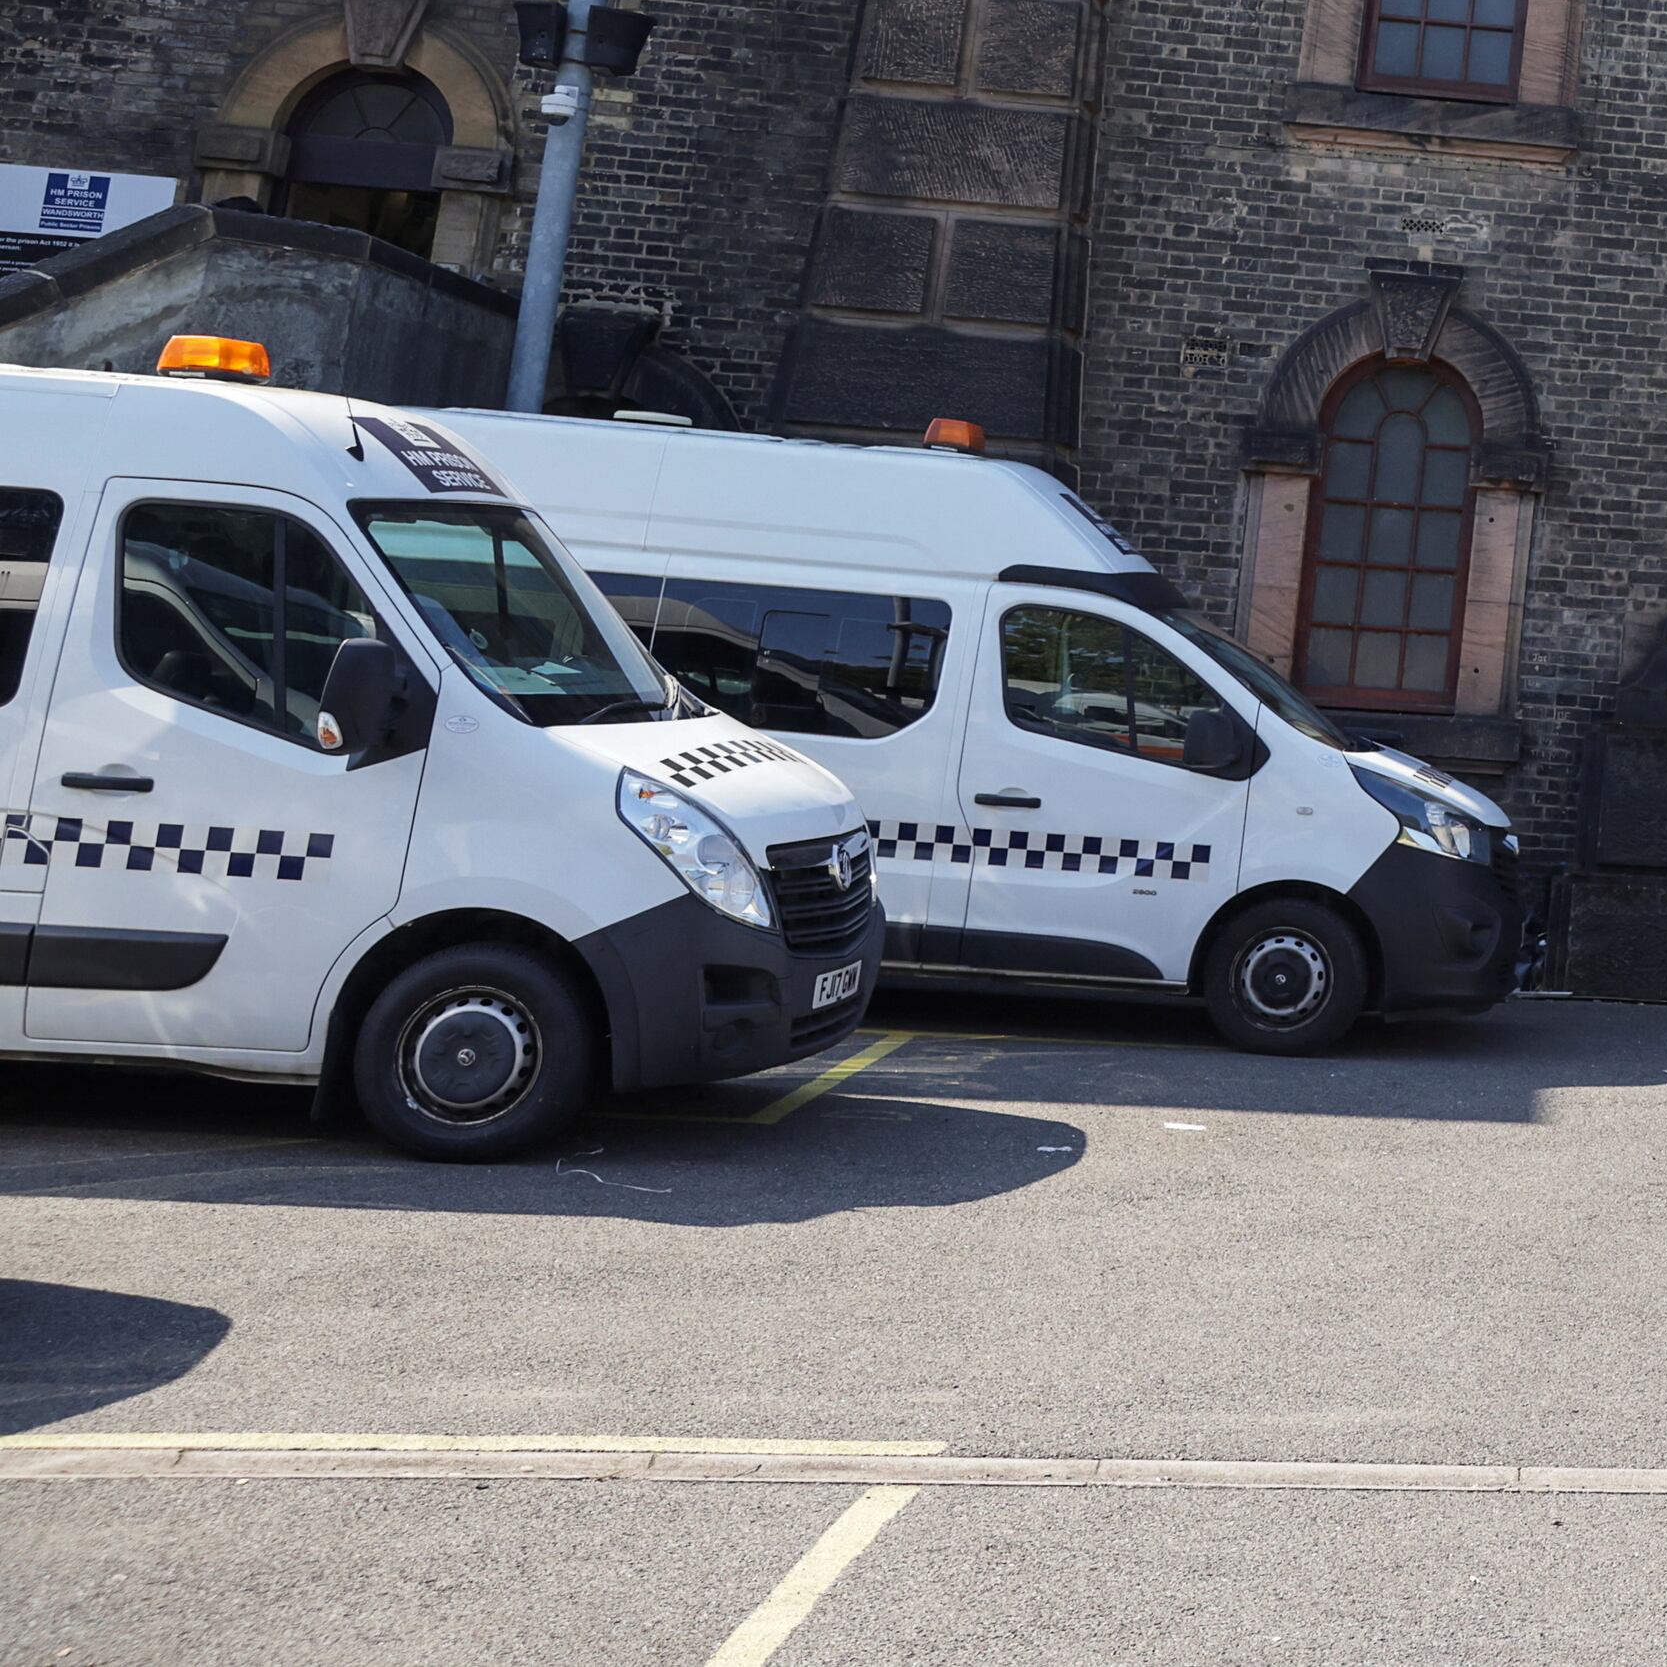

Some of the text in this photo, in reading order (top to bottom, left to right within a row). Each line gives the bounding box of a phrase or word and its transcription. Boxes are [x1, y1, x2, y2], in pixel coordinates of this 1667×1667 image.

[50, 189, 103, 199] HM PRISON
[55, 198, 95, 207] SERVICE
[42, 209, 104, 219] WANDSWORTH
[401, 451, 433, 466] HM
[432, 470, 491, 490] SERVICE
[819, 972, 843, 1002] FJ17
